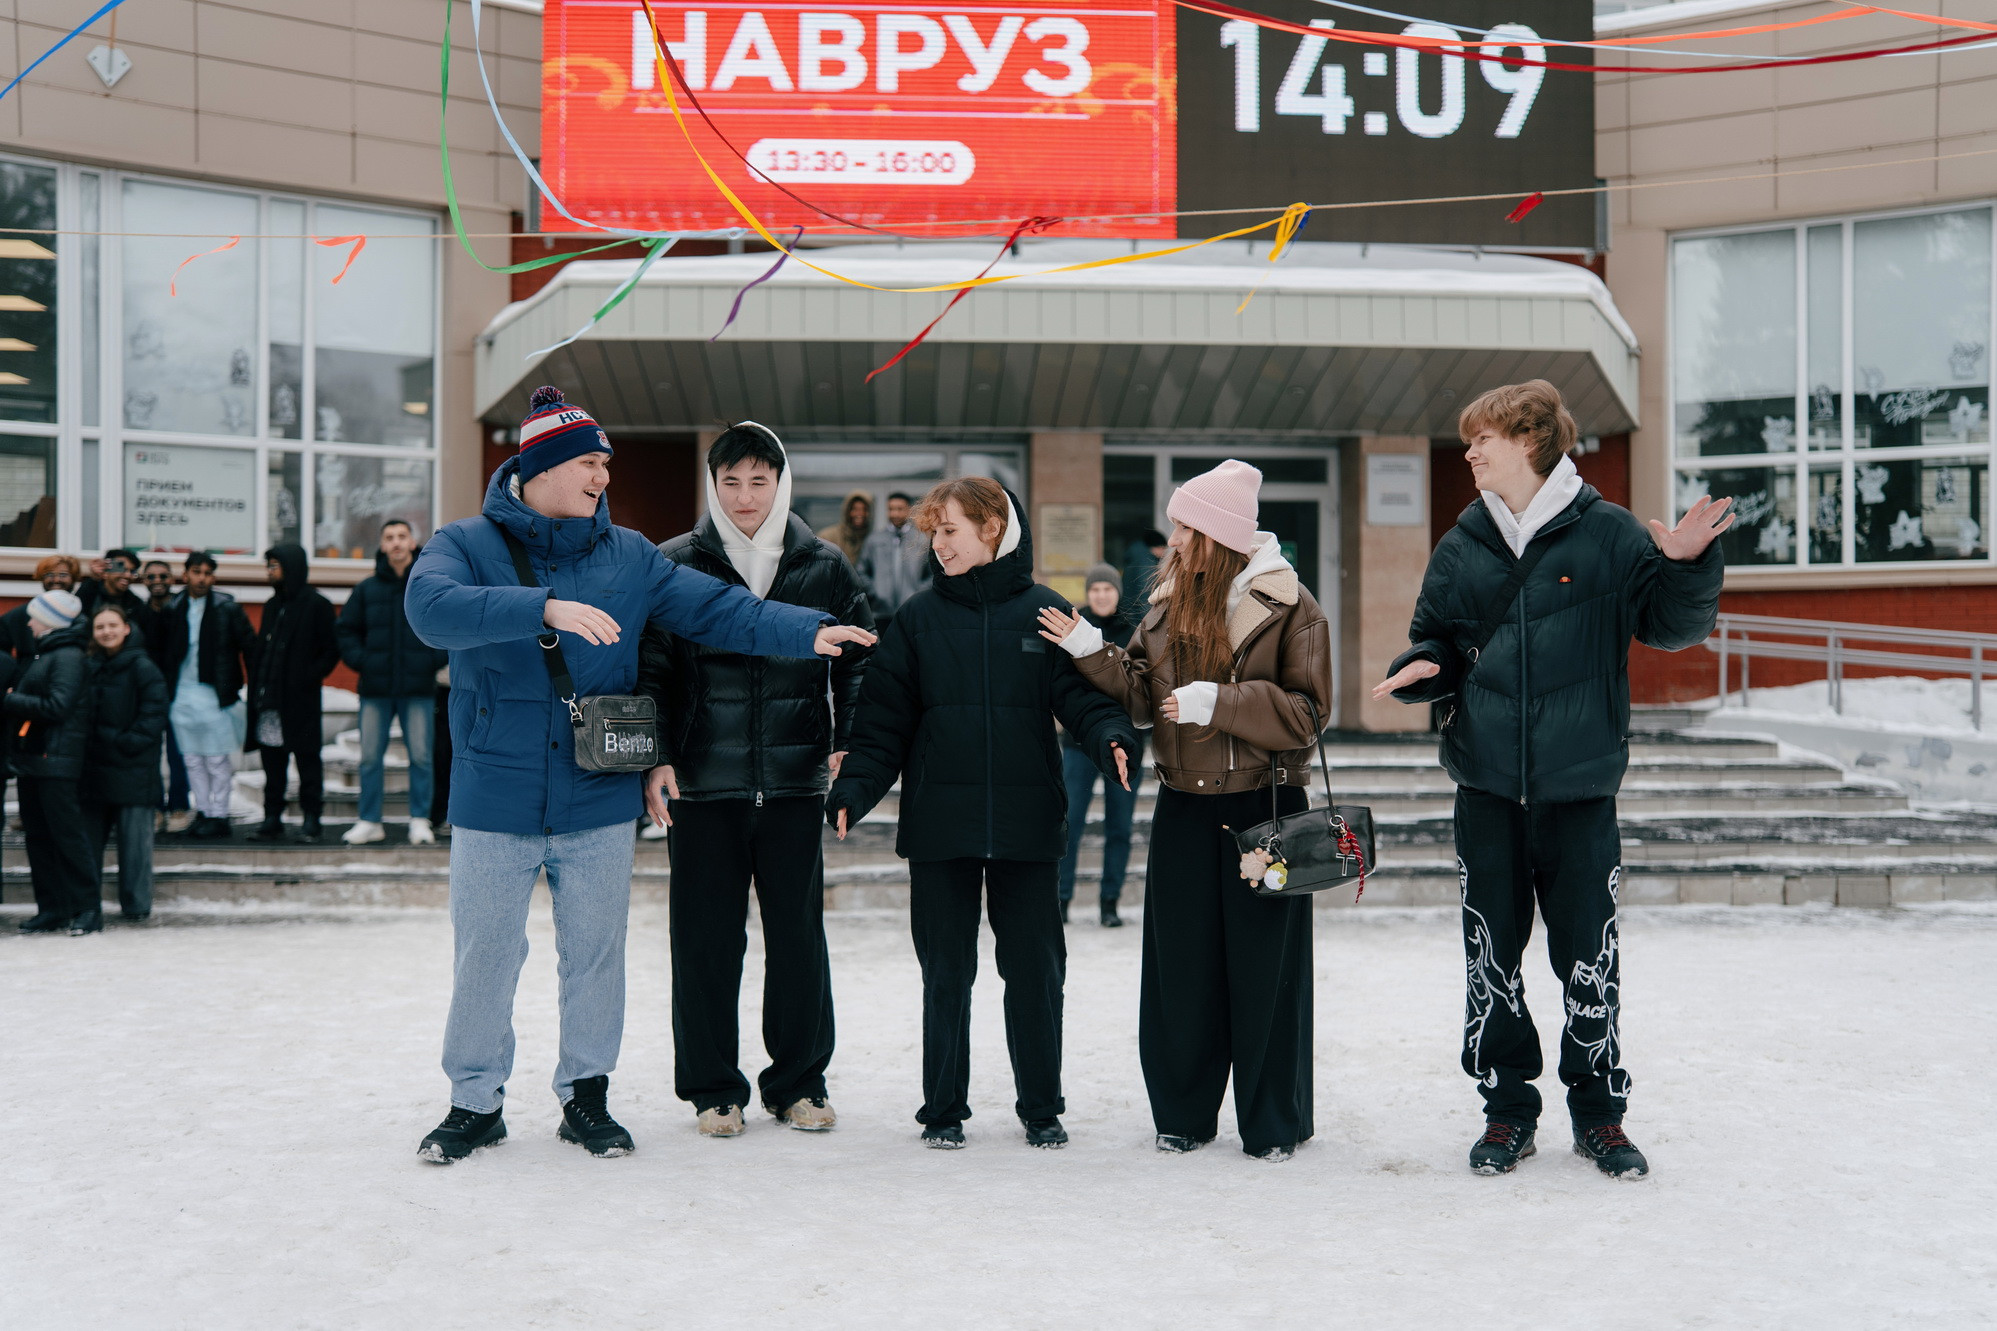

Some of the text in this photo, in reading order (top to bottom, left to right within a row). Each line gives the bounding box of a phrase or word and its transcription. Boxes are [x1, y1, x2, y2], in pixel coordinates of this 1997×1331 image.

[632, 9, 1093, 97] НАВРУЗ
[1220, 18, 1547, 139] 14:09
[766, 150, 848, 172] 13:30
[876, 151, 956, 173] 16:00
[136, 479, 193, 492] ПРИЕМ
[136, 495, 246, 512] ДОКУМЕНТОВ
[136, 511, 190, 525] ЗДЕСЬ
